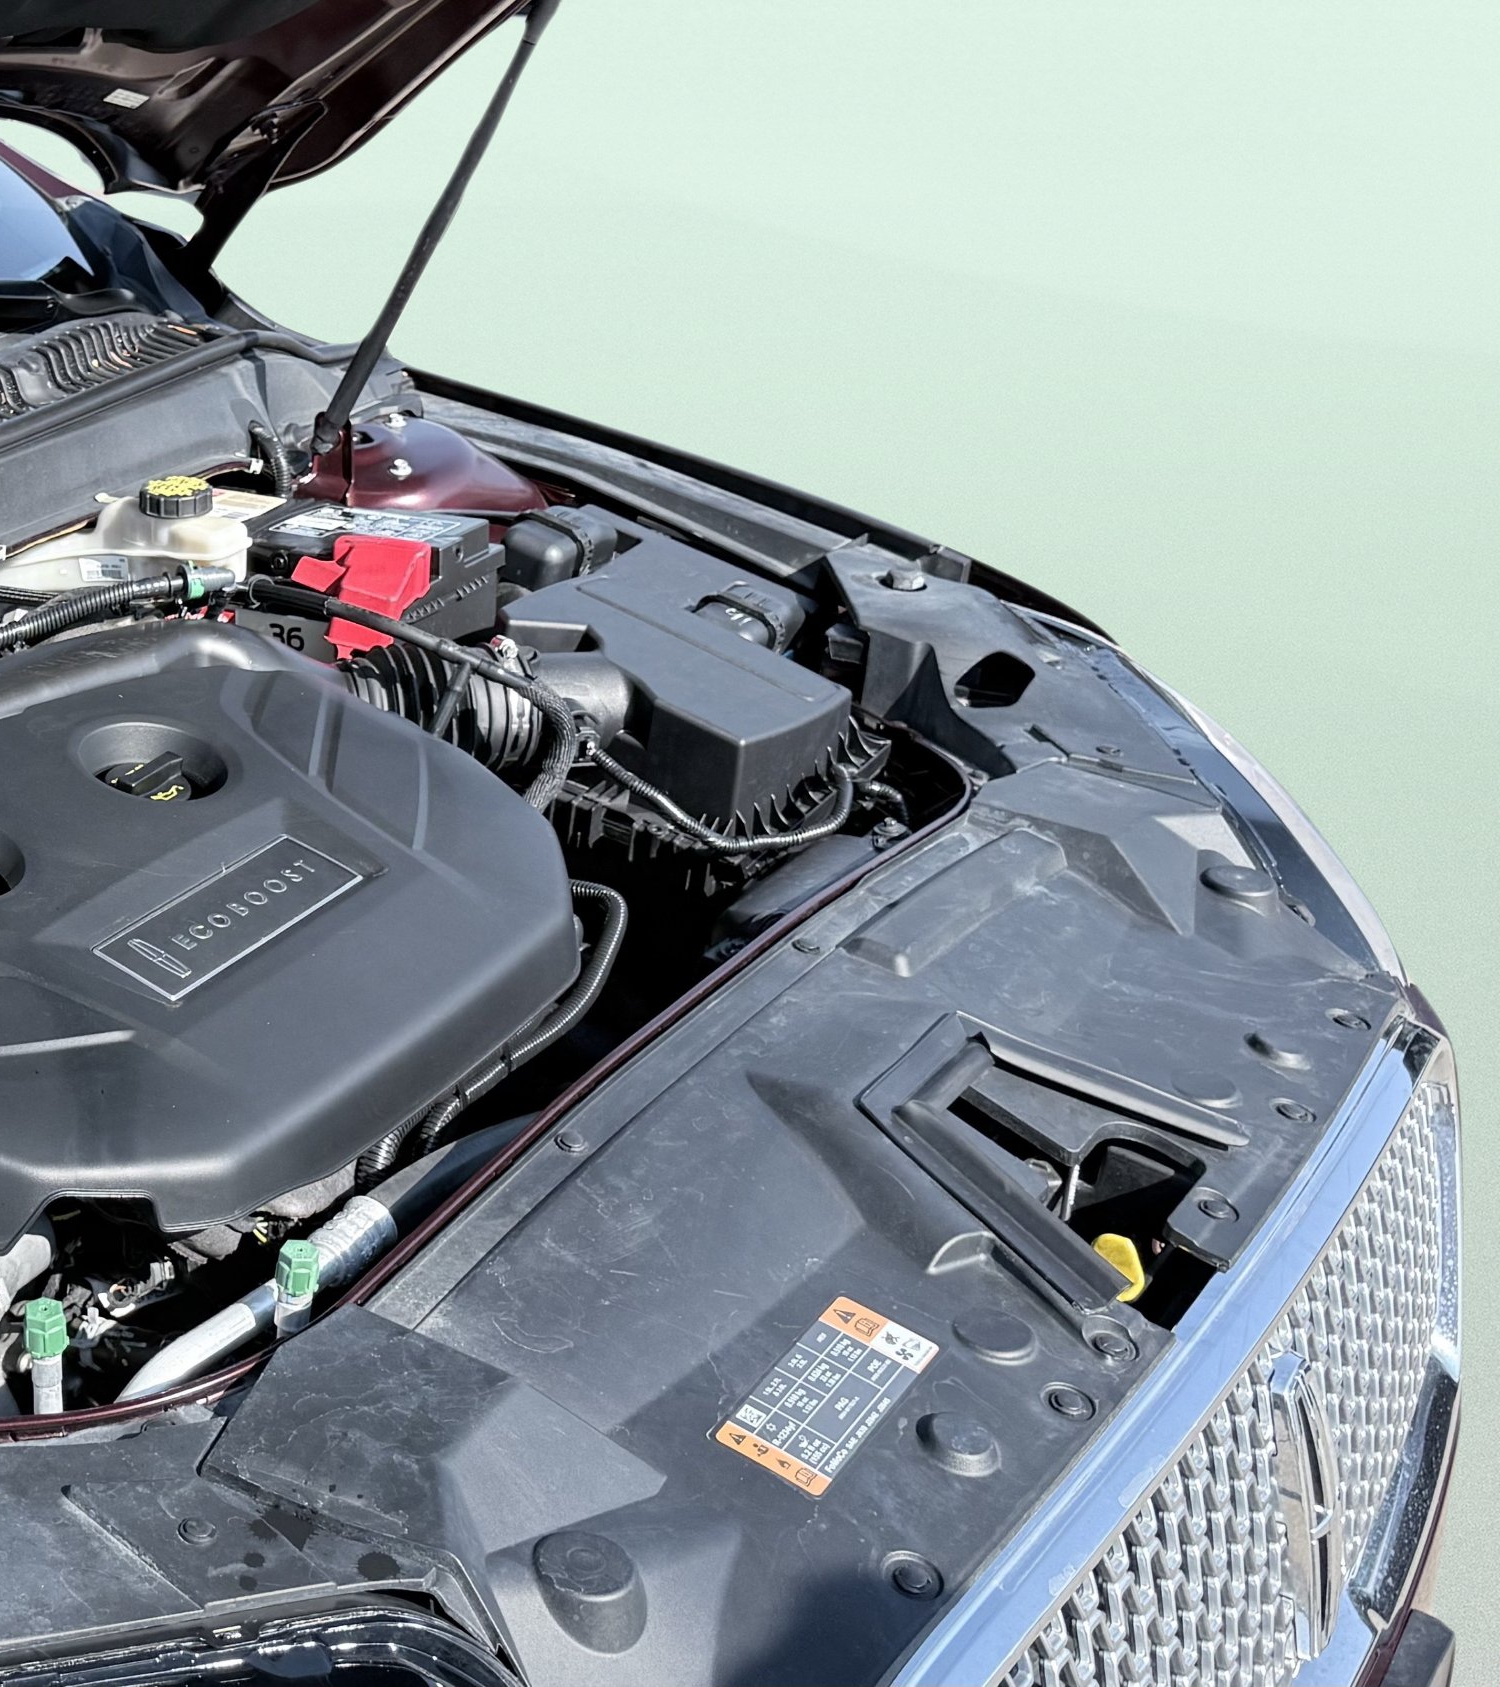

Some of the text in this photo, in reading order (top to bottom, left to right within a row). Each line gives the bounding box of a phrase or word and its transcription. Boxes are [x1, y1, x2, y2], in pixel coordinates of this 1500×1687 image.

[269, 623, 305, 651] 36
[169, 860, 315, 950] ECOBOOST
[865, 1358, 882, 1372] POE
[833, 1396, 849, 1411] PAG
[771, 1420, 798, 1447] R-1234yf
[823, 1447, 849, 1473] FoMoCo
[844, 1436, 858, 1449] SAE
